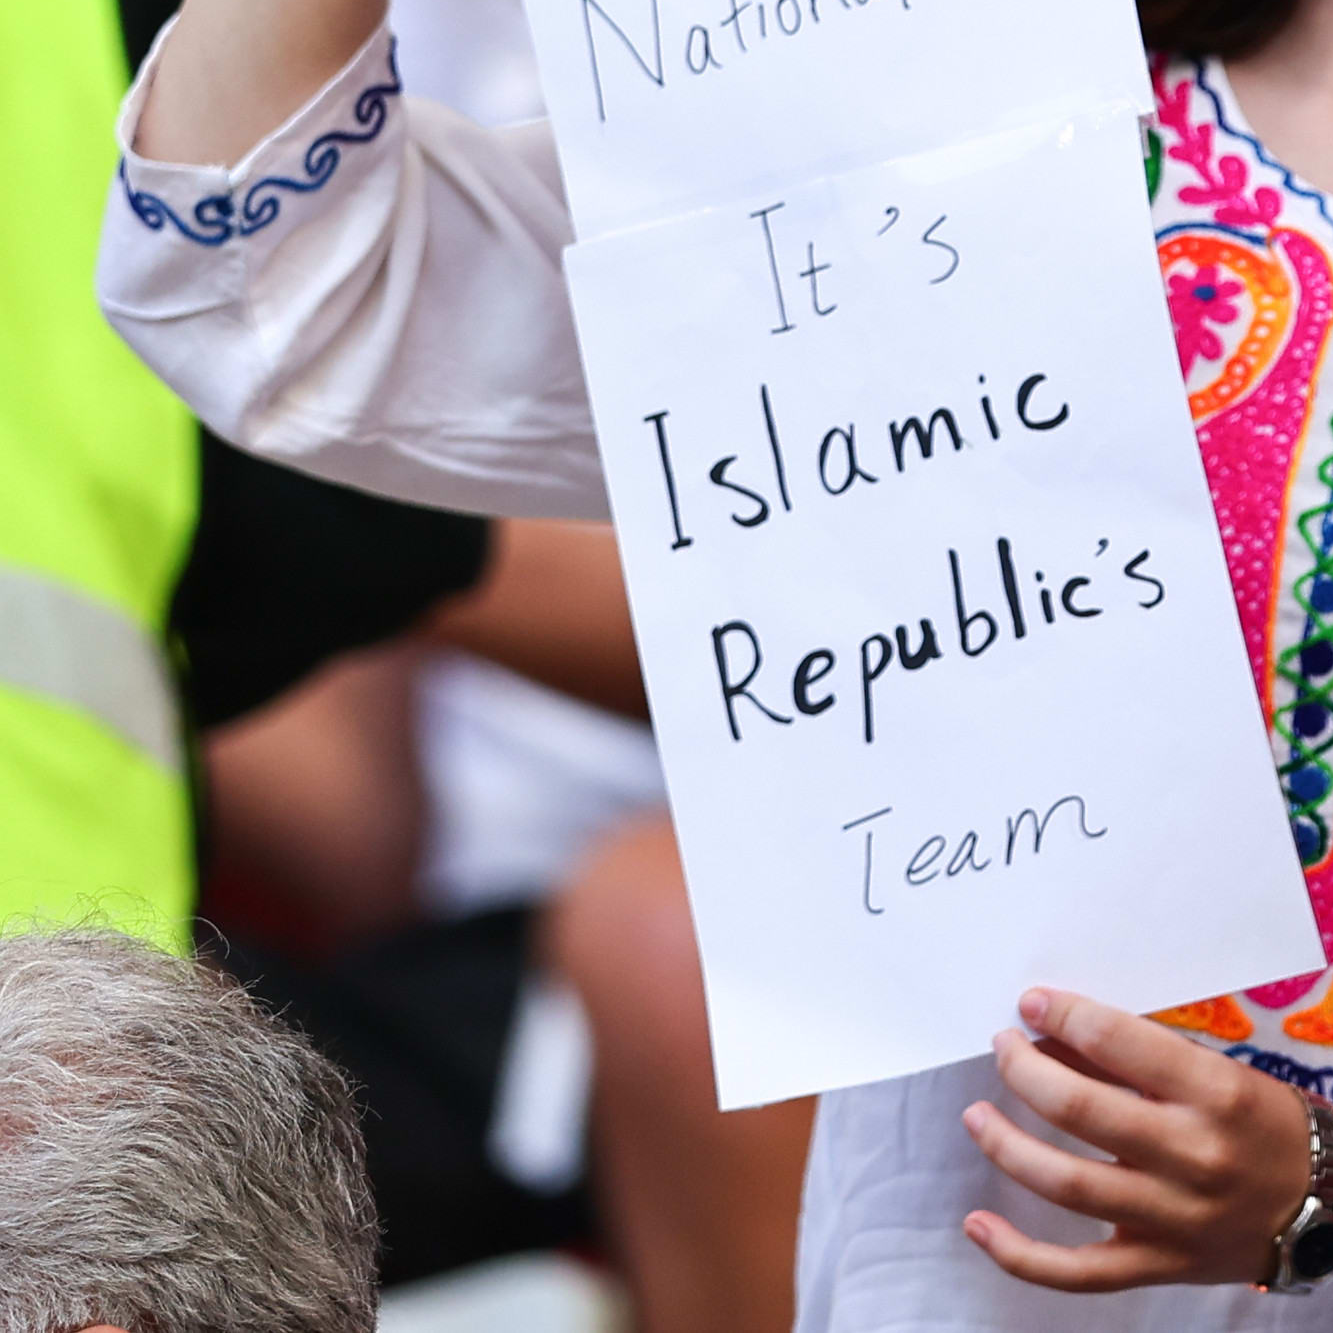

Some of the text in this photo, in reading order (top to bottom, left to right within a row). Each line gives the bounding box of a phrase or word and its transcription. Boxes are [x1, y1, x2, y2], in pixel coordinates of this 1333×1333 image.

[749, 201, 961, 335] It's
[643, 372, 1071, 552] Islamic
[710, 536, 1166, 744] Republic's
[841, 794, 1109, 916] Team
